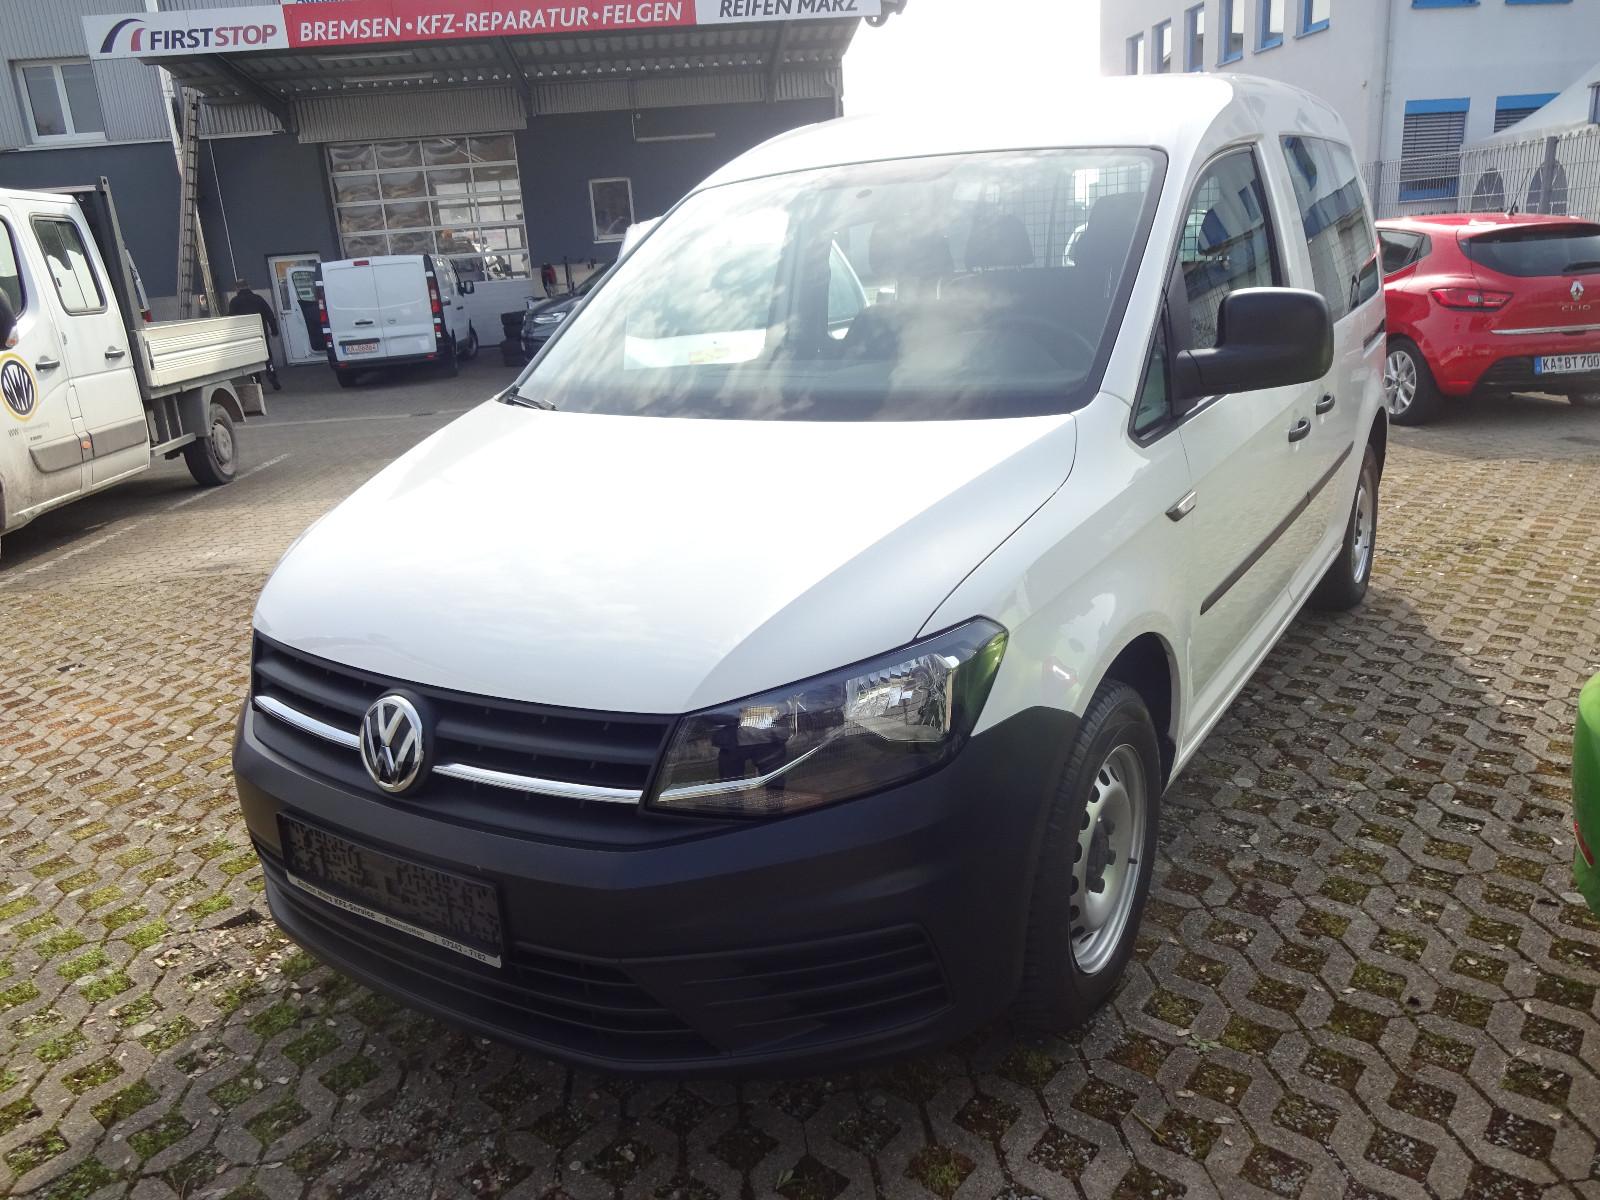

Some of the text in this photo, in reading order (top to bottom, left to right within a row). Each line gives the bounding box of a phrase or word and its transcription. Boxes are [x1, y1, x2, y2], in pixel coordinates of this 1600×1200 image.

[719, 0, 792, 18] REIFEN
[300, 2, 682, 42] BREMSEN KFZ-REPARATUR FELGEN
[1542, 357, 1557, 371] KA
[1564, 355, 1578, 369] BT
